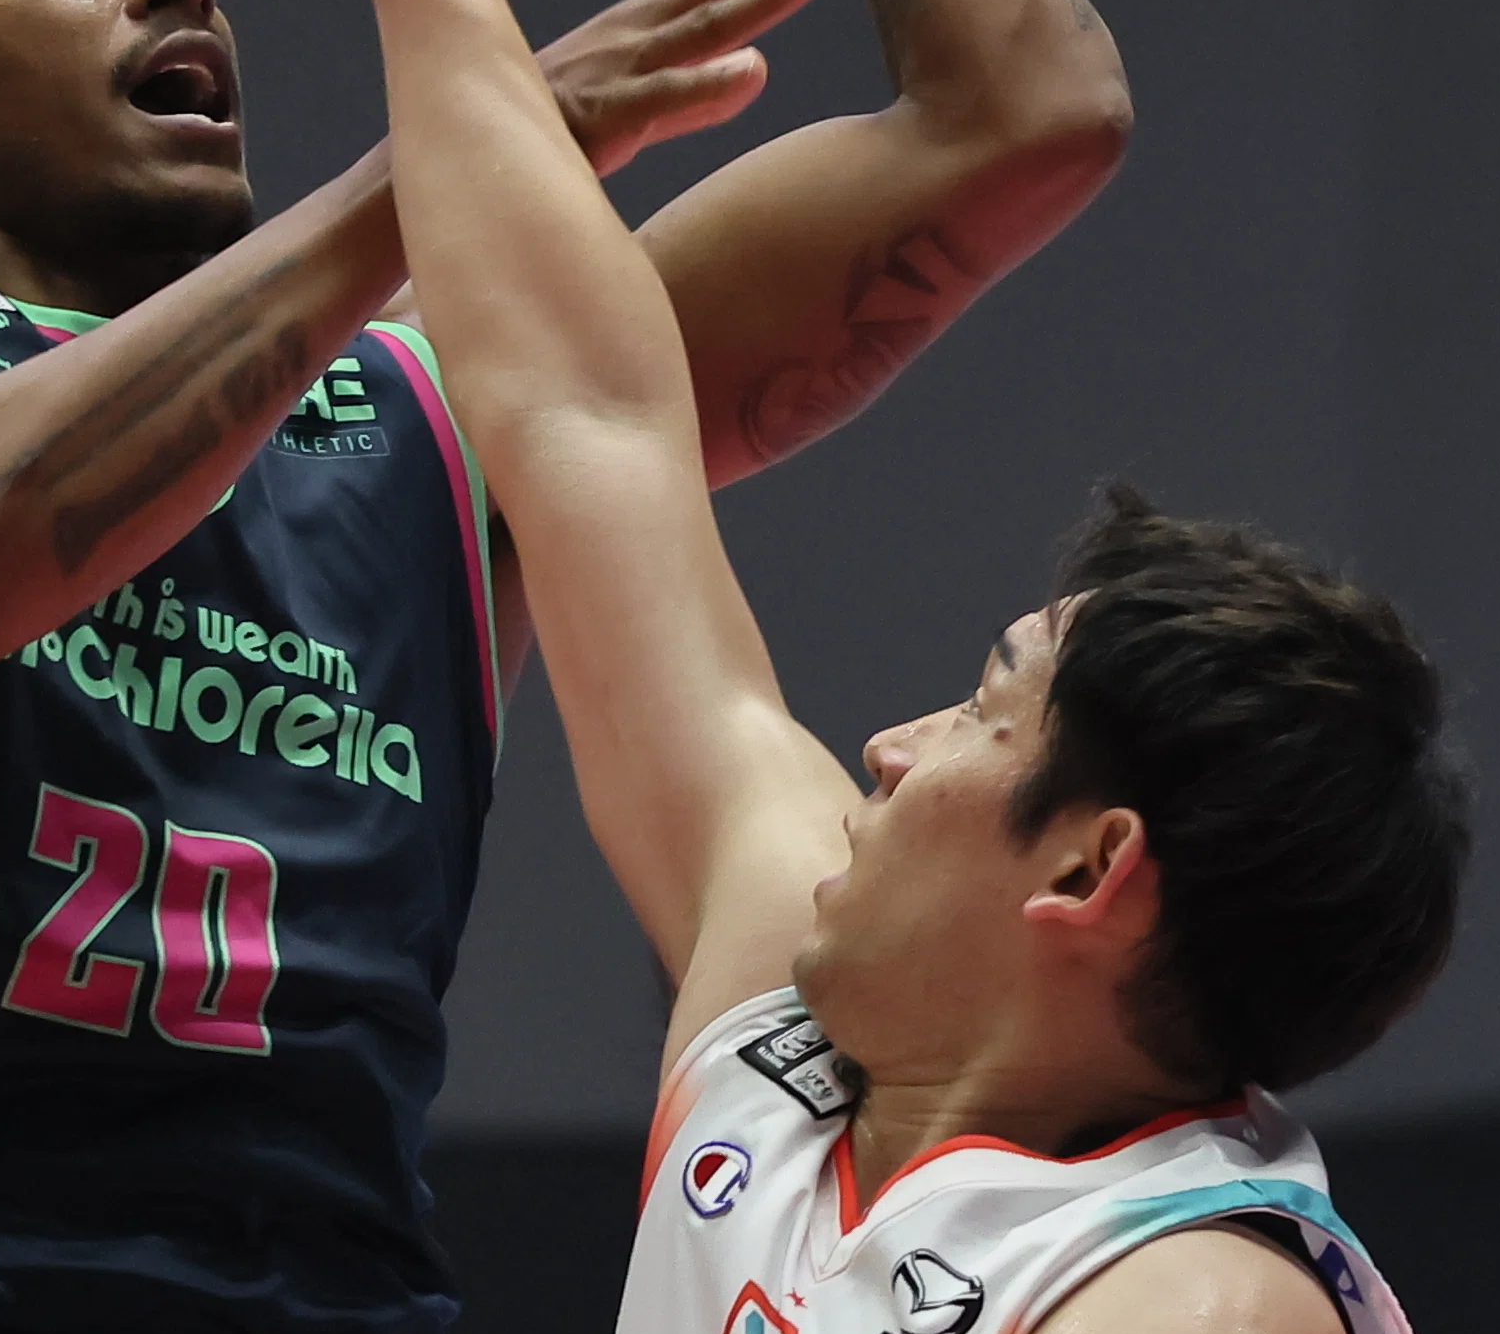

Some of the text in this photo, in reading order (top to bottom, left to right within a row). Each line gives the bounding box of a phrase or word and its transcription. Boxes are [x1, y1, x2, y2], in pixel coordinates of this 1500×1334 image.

[270, 430, 374, 454] THLETIC
[153, 577, 187, 641] is
[1, 781, 282, 1058] 20
